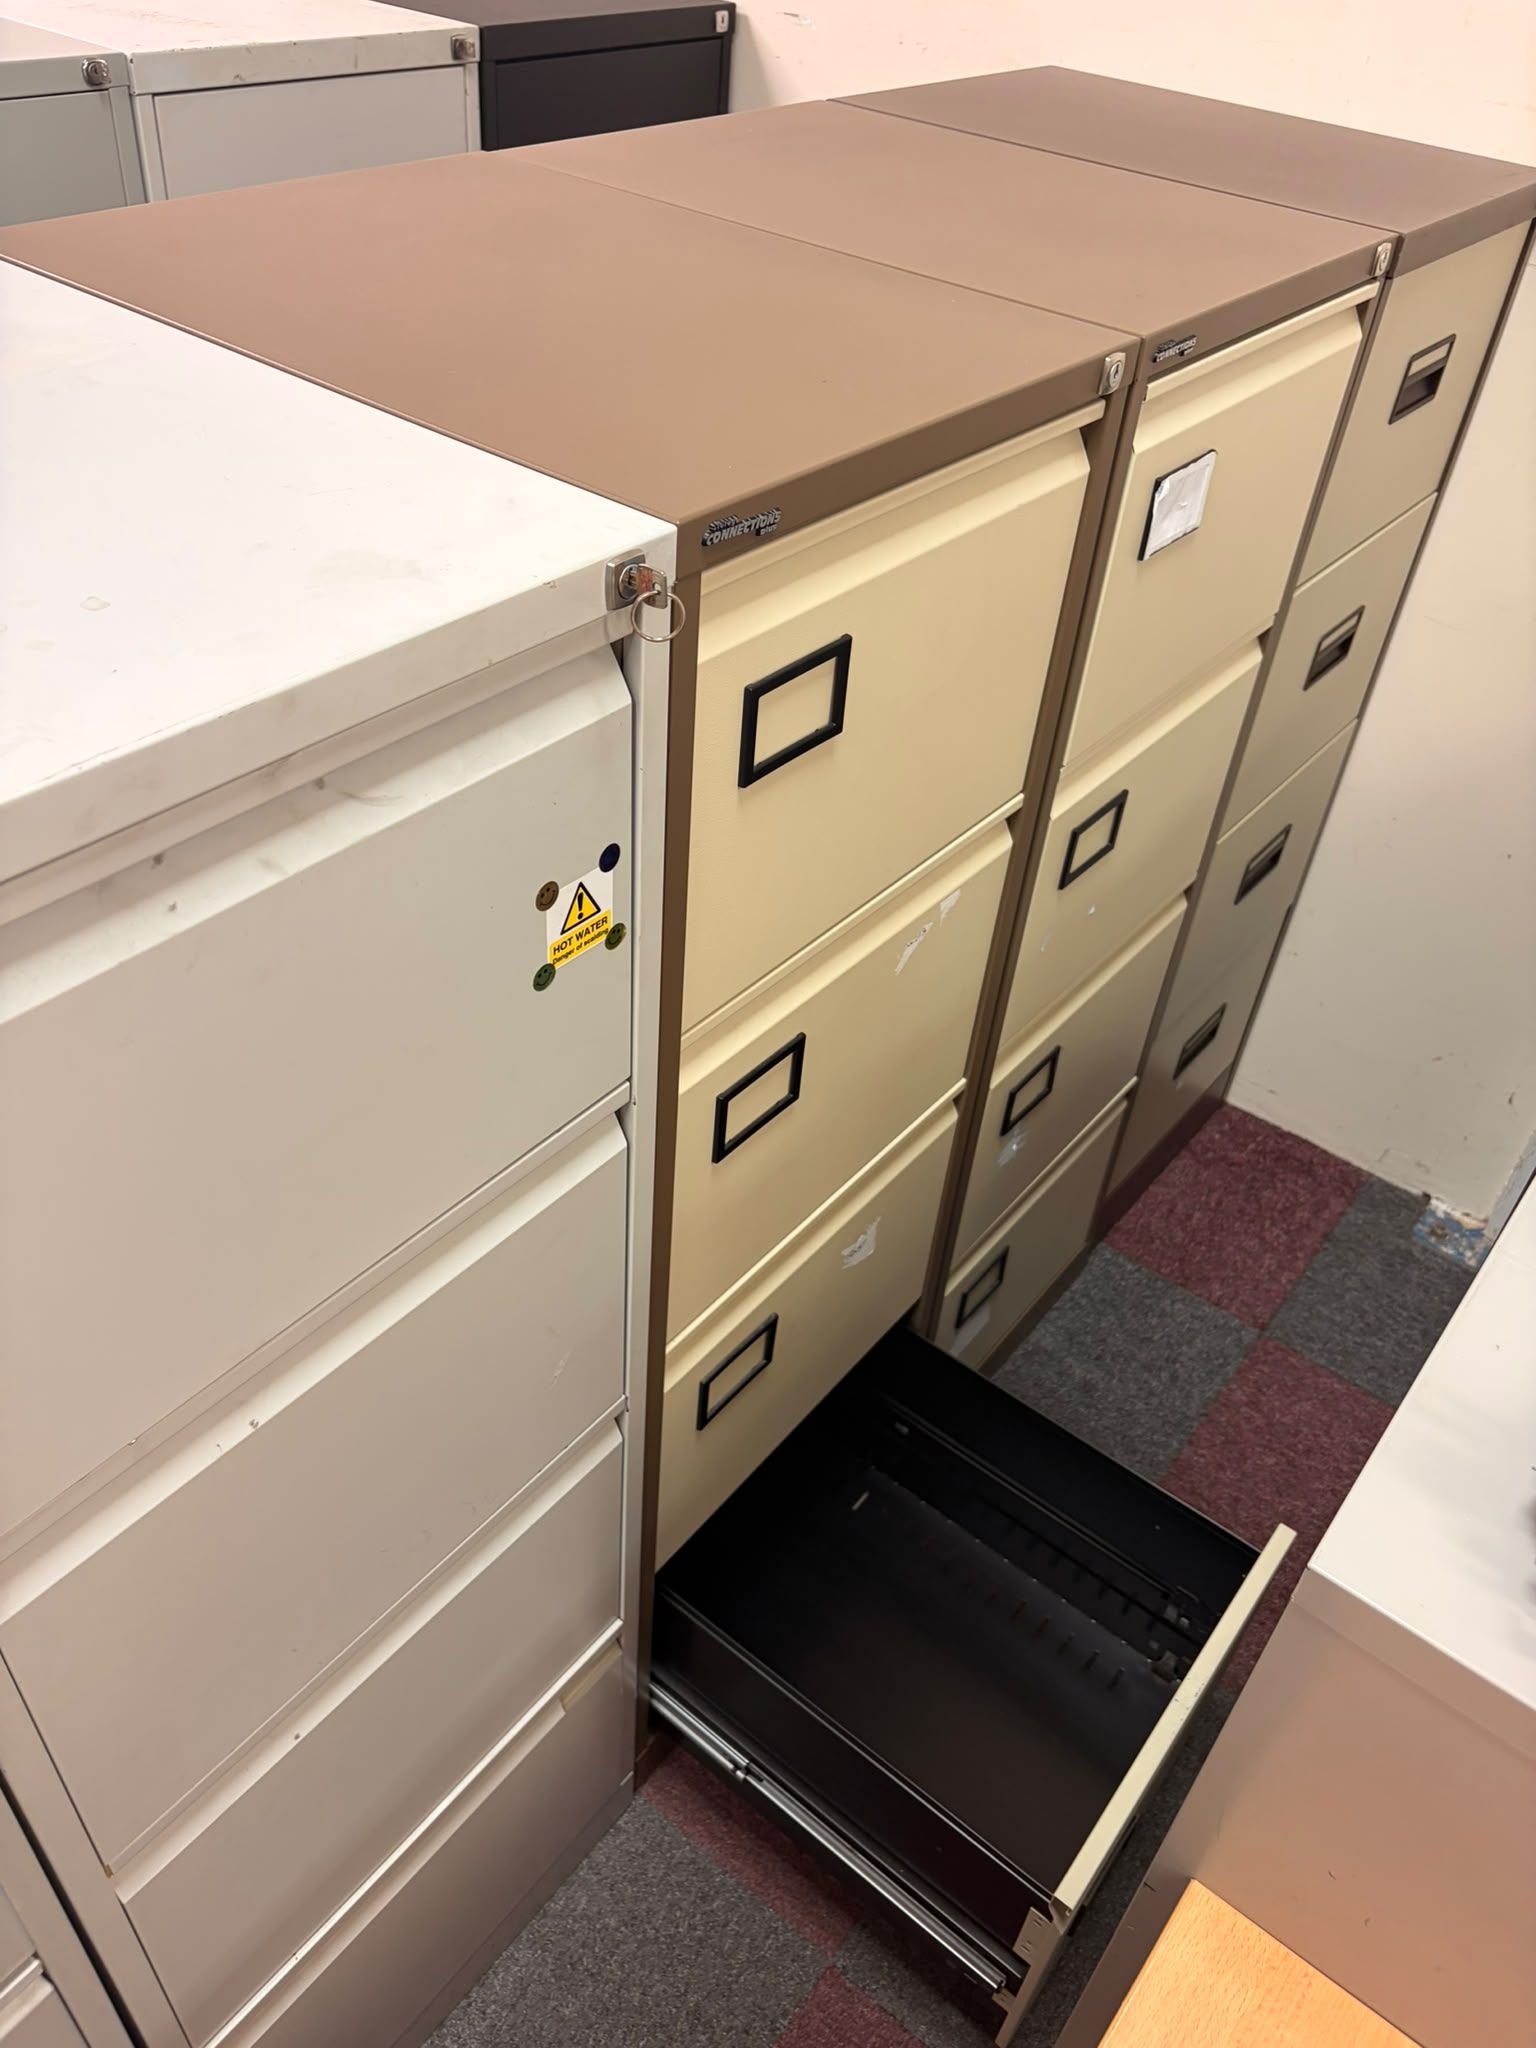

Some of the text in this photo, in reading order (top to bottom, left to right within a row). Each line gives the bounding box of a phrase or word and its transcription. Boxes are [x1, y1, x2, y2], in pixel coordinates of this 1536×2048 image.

[706, 509, 781, 545] CONNECTIONS
[552, 948, 575, 965] Danger
[576, 942, 583, 951] of
[553, 916, 608, 955] HOT WATER
